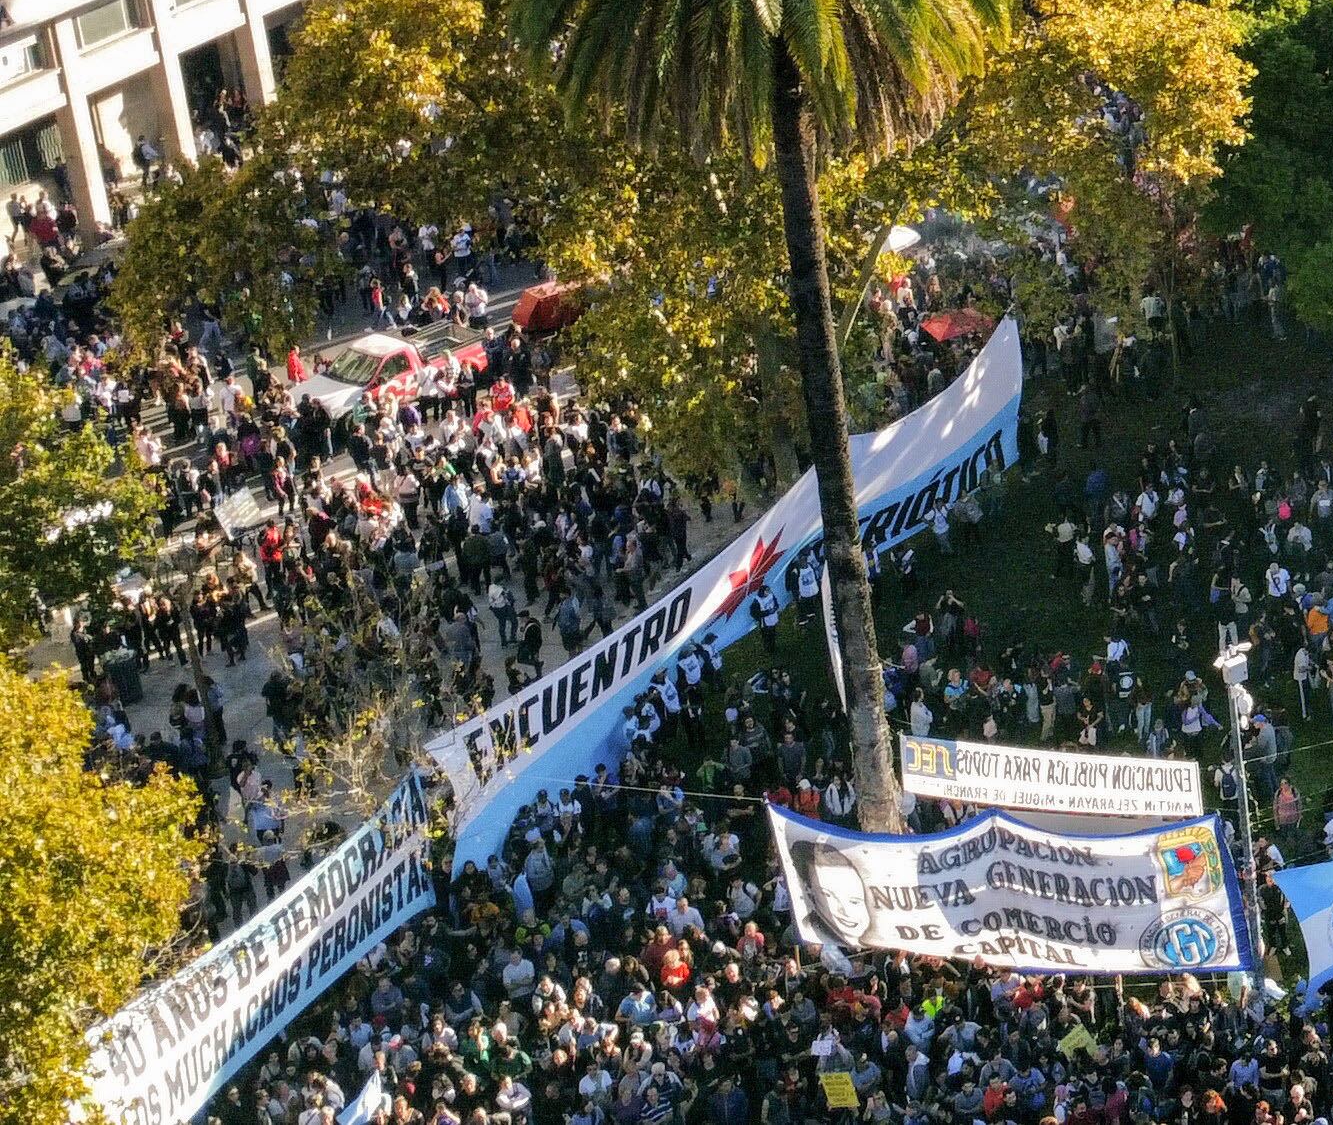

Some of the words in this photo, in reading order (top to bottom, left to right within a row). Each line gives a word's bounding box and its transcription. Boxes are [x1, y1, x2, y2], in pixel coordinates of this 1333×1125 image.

[463, 587, 693, 789] ENCUENTRO
[870, 878, 976, 912] NUEVA
[896, 924, 945, 941] DE
[230, 933, 270, 986] DE
[165, 956, 303, 1115] MUCHACHOS
